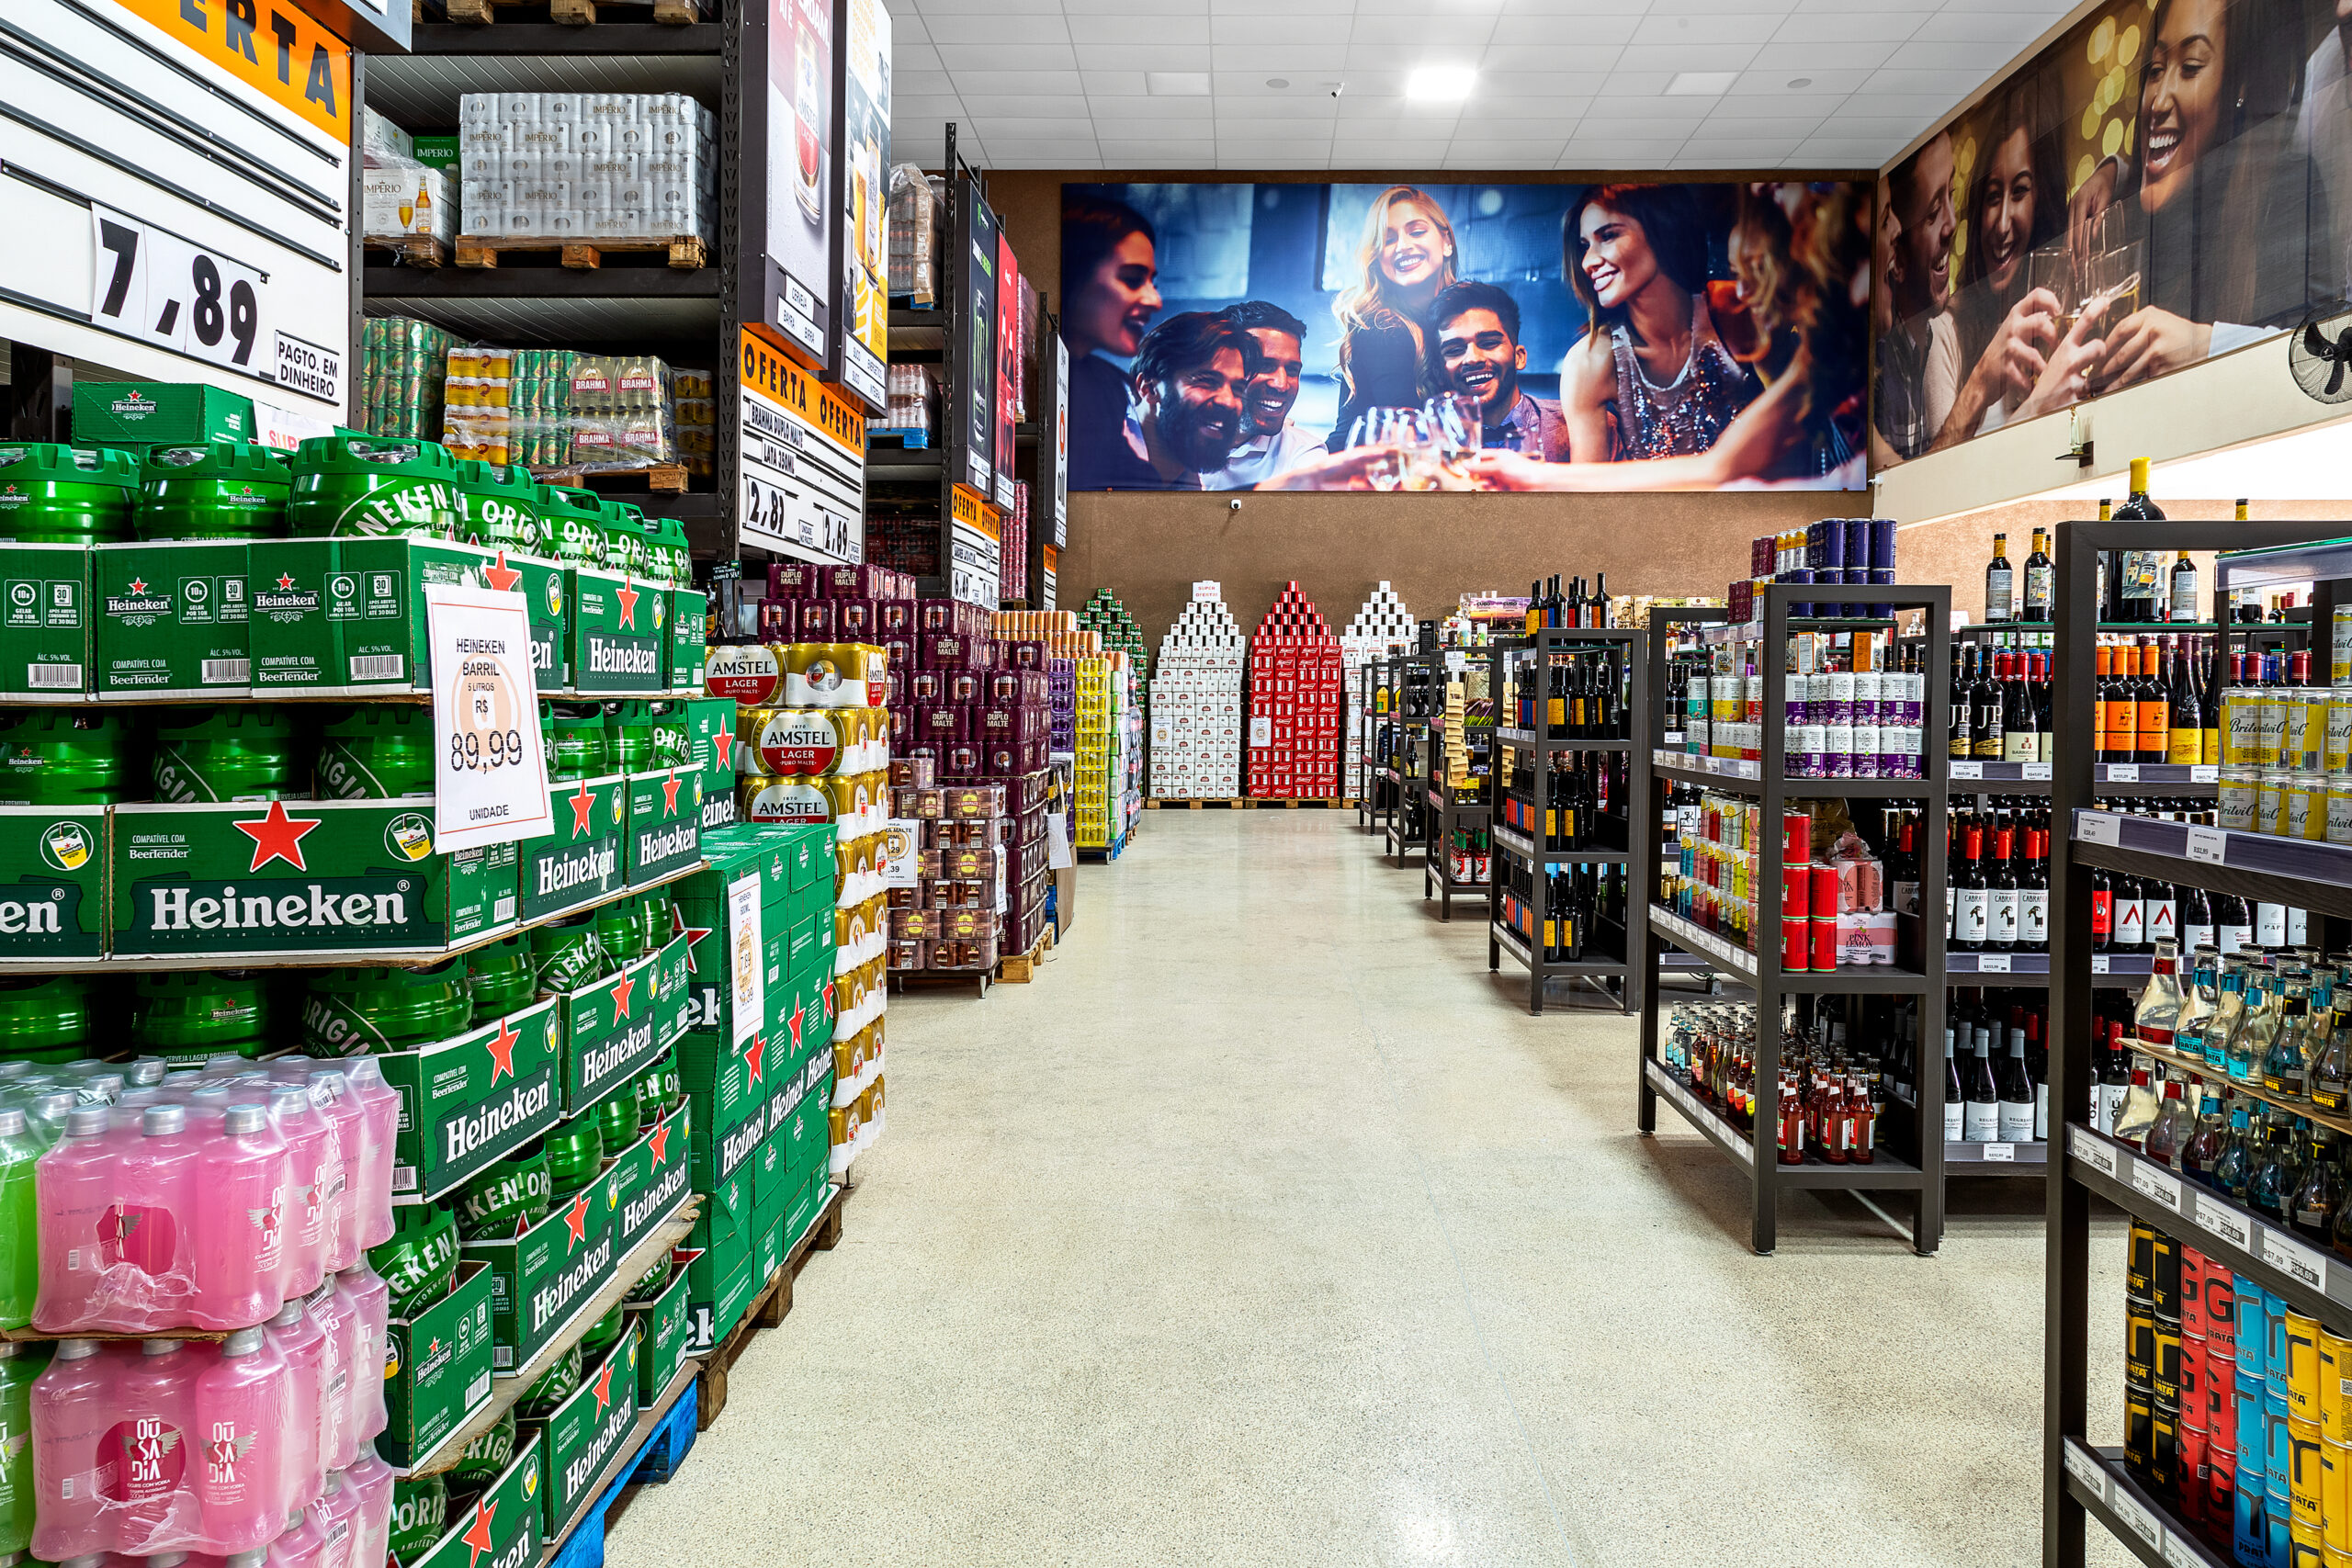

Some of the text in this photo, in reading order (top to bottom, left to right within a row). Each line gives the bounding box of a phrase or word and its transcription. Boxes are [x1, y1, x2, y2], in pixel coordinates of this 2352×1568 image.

[99, 217, 257, 367] 7,89
[278, 341, 338, 378] PAGTO. EM
[280, 367, 335, 398] DINHEIRO
[575, 378, 652, 389] BRAHMA BRAHMA
[744, 343, 862, 448] OFERTA OFERTA
[115, 402, 156, 412] Heineken
[752, 404, 803, 448] BRAHMA DUPLO MALTE
[269, 429, 299, 450] SUP
[579, 432, 656, 446] BRAHMA BRAHMA
[763, 443, 795, 474] LATA 350ML
[0, 494, 28, 502] eineken
[229, 494, 266, 503] Heineken
[953, 493, 1000, 537] OFERTA OFERTA
[825, 514, 848, 556] 2,69
[834, 578, 856, 586] MALTE
[108, 599, 169, 612] Heineken
[256, 595, 316, 606] Heineken
[456, 638, 505, 654] HEINEKEN
[937, 648, 959, 656] MALTE
[938, 641, 959, 649] DUPLO
[60, 653, 73, 661] VOL.
[261, 656, 315, 666] COMPATÍVEL COM
[589, 637, 657, 673] Heineken
[112, 660, 166, 670] COMPATÍVEL COM
[462, 661, 500, 676] BARRIL
[712, 661, 771, 675] AMSTEL
[110, 674, 171, 685] BeerTender
[259, 671, 319, 682] BeerTender
[725, 679, 758, 688] LAGER
[468, 682, 495, 691] 5 LITROS
[475, 698, 489, 715] R$
[932, 713, 1009, 721] DUPLO DUPLO
[1949, 705, 2003, 729] JP JP
[768, 731, 829, 745] AMSTEL
[450, 729, 523, 774] 89,99
[781, 750, 815, 759] LAGER
[8, 757, 44, 766] Heineken
[469, 805, 510, 821] UNIDADE
[758, 801, 822, 815] AMSTEL
[132, 834, 186, 844] COMPATÍVEL COM
[639, 826, 696, 867] Heineken
[888, 846, 900, 854] ,29
[130, 848, 189, 860] BeerTender
[888, 865, 900, 874] ,39
[151, 886, 409, 931] Heineken
[582, 1025, 651, 1089] Heineken
[432, 1078, 469, 1100] BeerTender
[769, 1068, 804, 1132] Heine
[446, 1079, 549, 1164] Heineken
[722, 1104, 765, 1178] Heine
[623, 1165, 686, 1239] Heineken
[534, 1242, 611, 1333] Heineken
[417, 1348, 452, 1382] Heineken
[565, 1393, 633, 1504] Heineken
